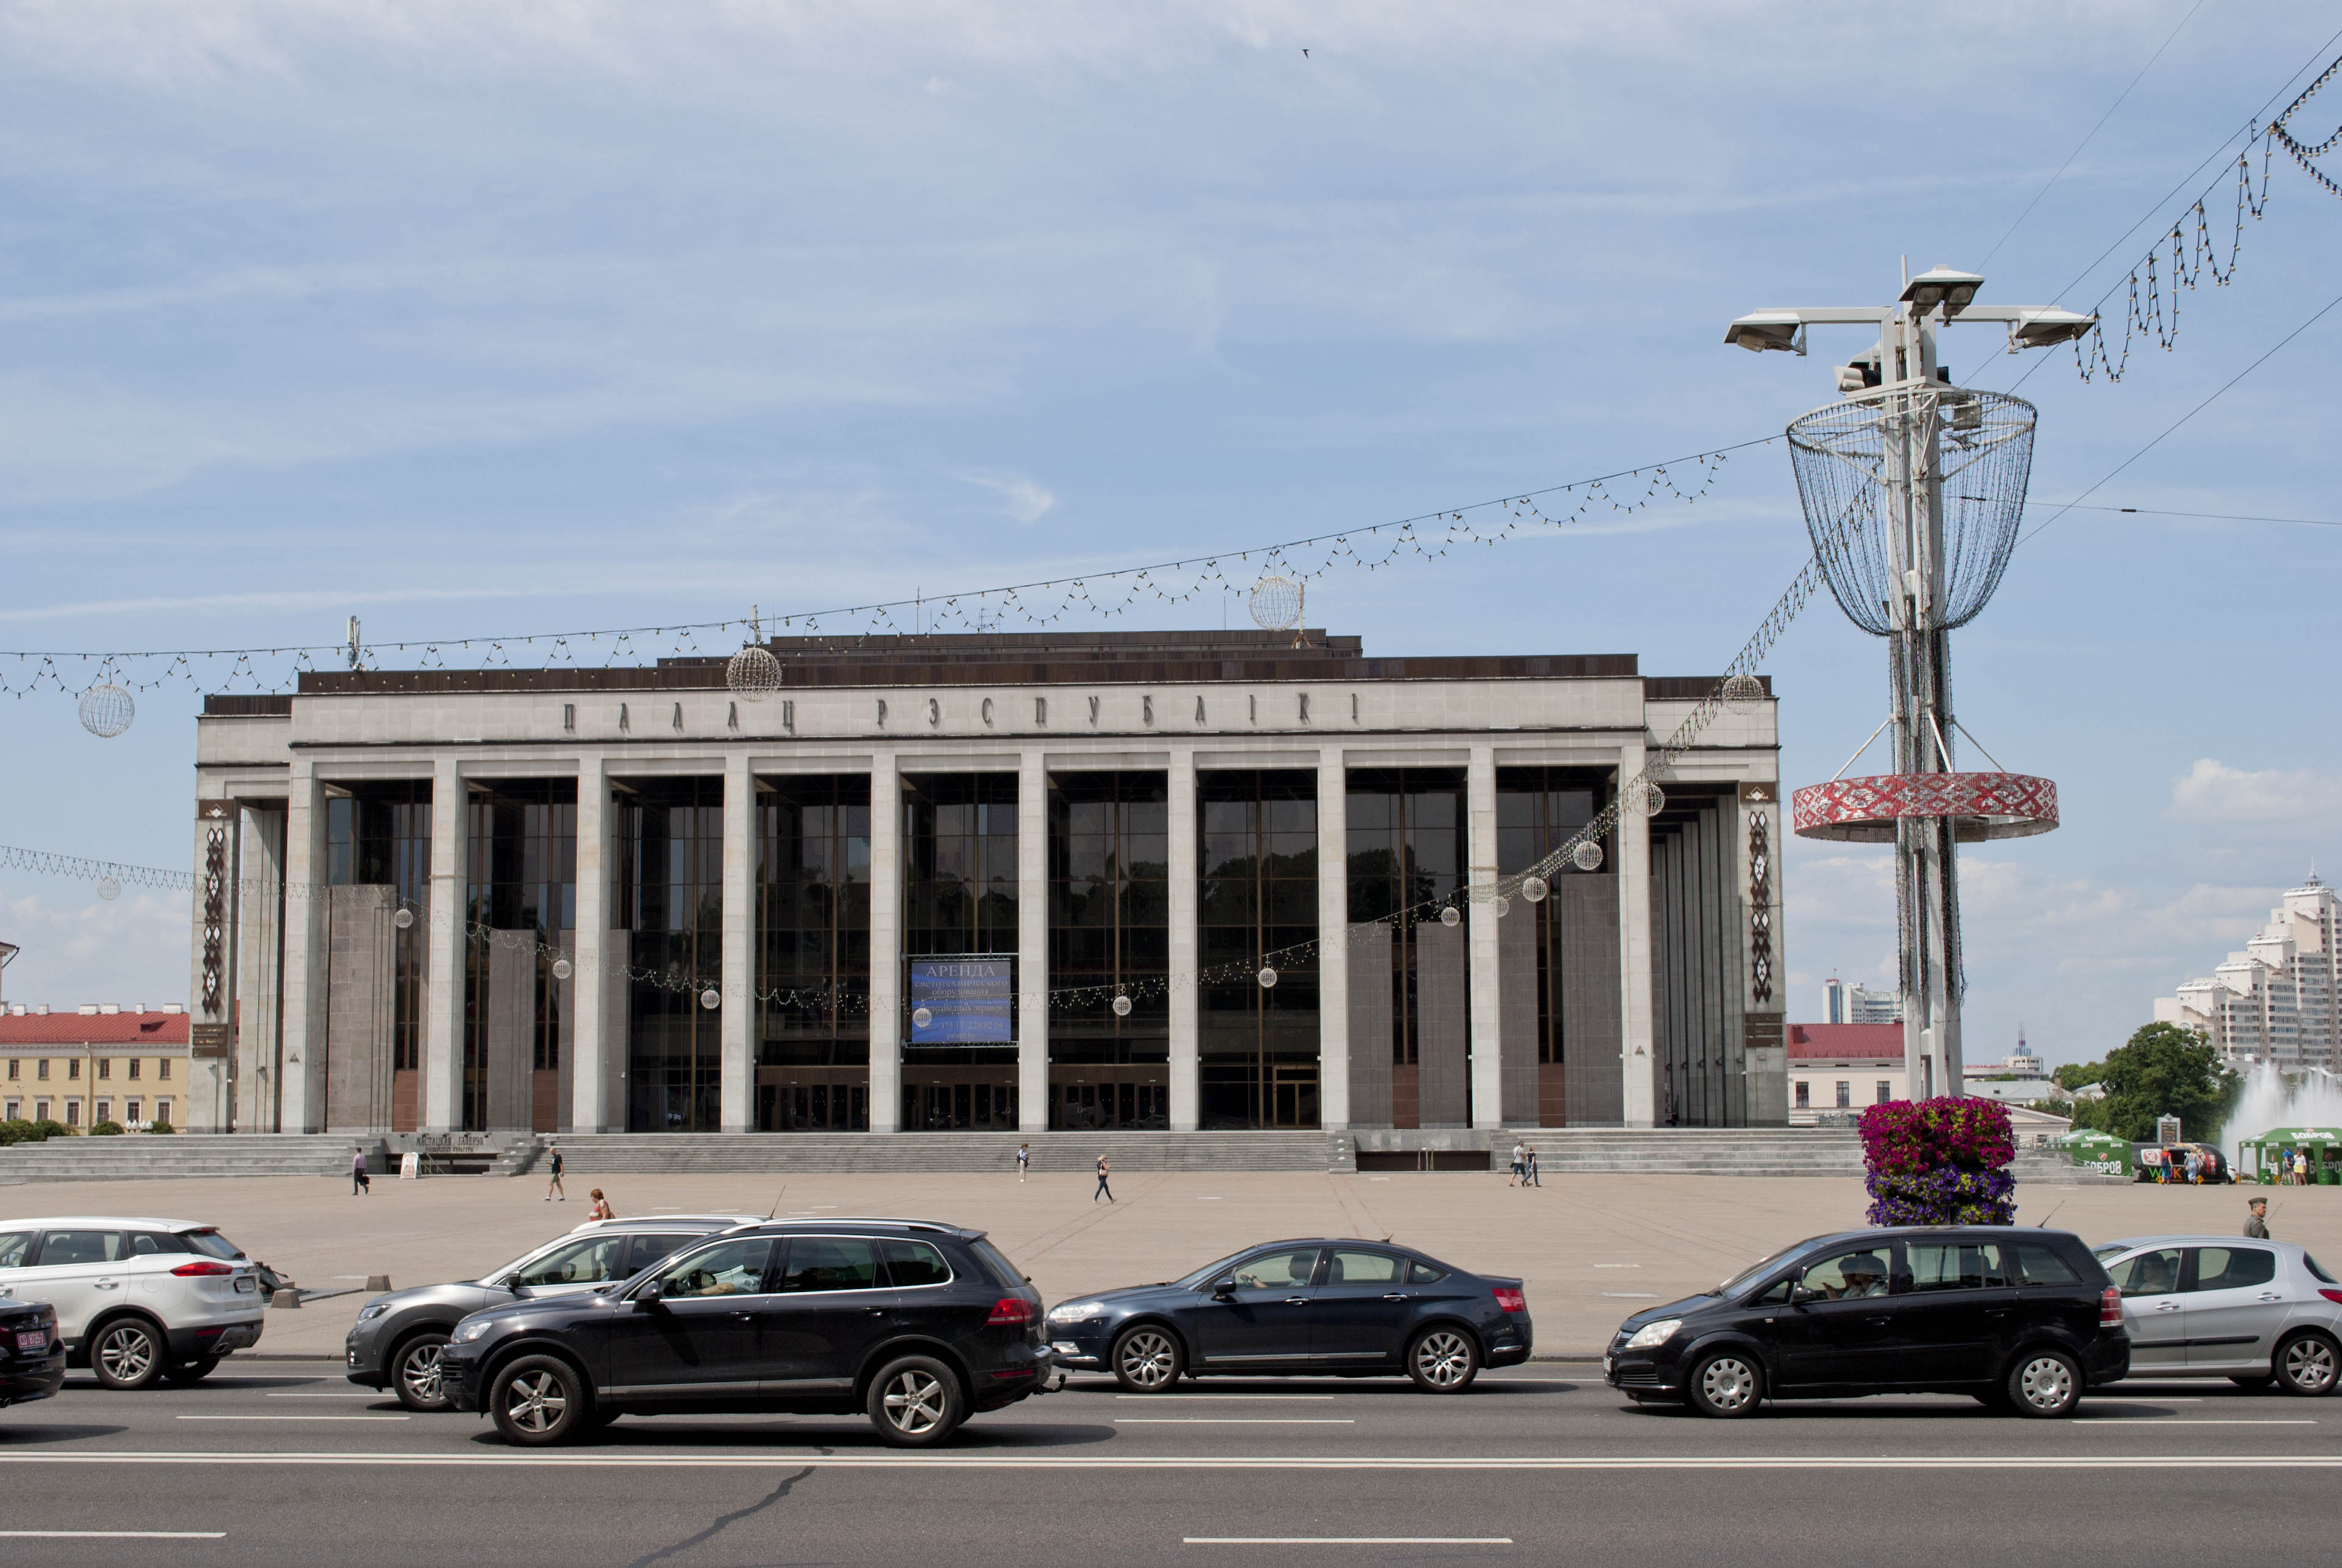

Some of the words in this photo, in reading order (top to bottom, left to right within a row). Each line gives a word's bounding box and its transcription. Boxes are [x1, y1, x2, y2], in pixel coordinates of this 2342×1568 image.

[564, 700, 794, 732] ПАЛАЦ
[877, 692, 1358, 725] РЭСПУБЛІКІ
[927, 965, 995, 977] АРЕНДА
[932, 987, 989, 997] оборудования
[416, 1137, 452, 1147] МАСТАЦКАЯ
[458, 1137, 484, 1145] ГАЛЕРЭЯ
